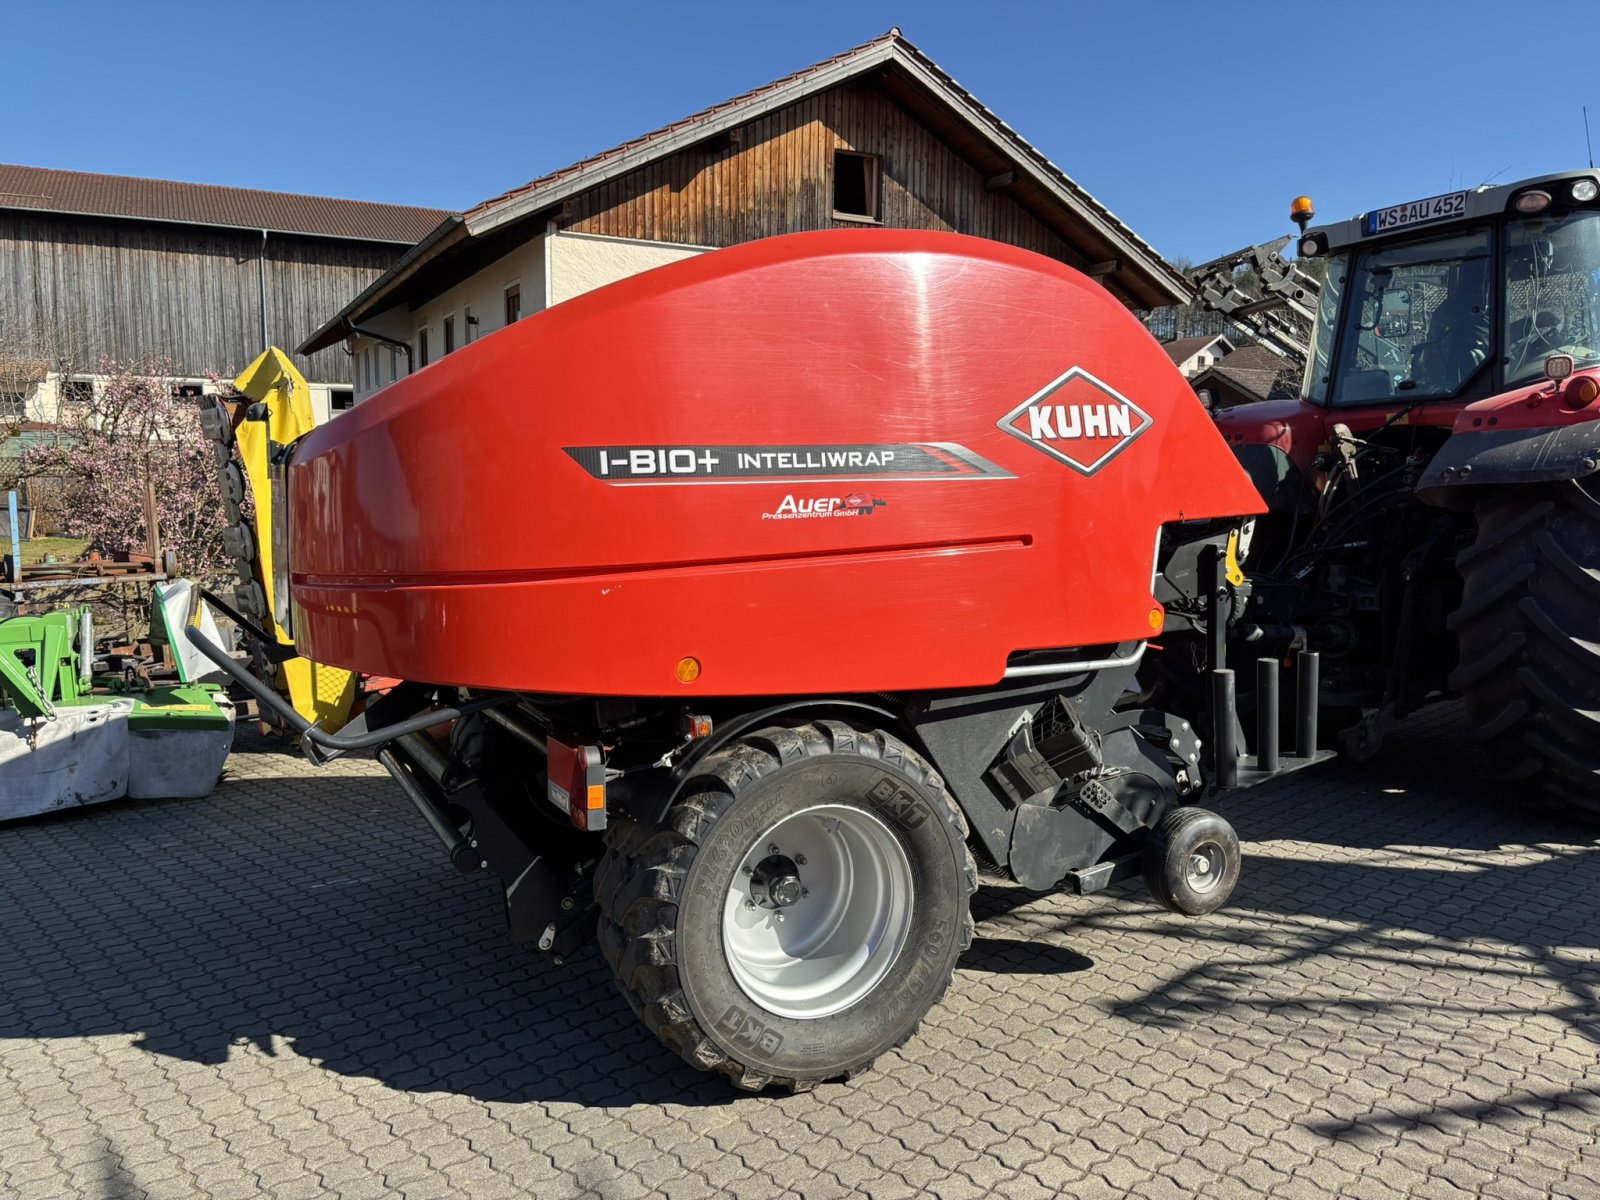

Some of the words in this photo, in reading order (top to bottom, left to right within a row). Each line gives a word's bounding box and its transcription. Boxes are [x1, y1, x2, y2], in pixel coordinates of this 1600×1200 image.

[1378, 209, 1398, 228] WS
[1408, 202, 1430, 221] AU
[1433, 194, 1465, 216] 452
[1028, 404, 1132, 439] KUHN
[600, 449, 719, 475] I-BIO+
[737, 451, 895, 469] INTELLIWRAP
[762, 511, 833, 520] Pressenzentrum
[833, 508, 859, 517] GmbH
[871, 779, 927, 825] BKT
[722, 1011, 780, 1049] BKT
